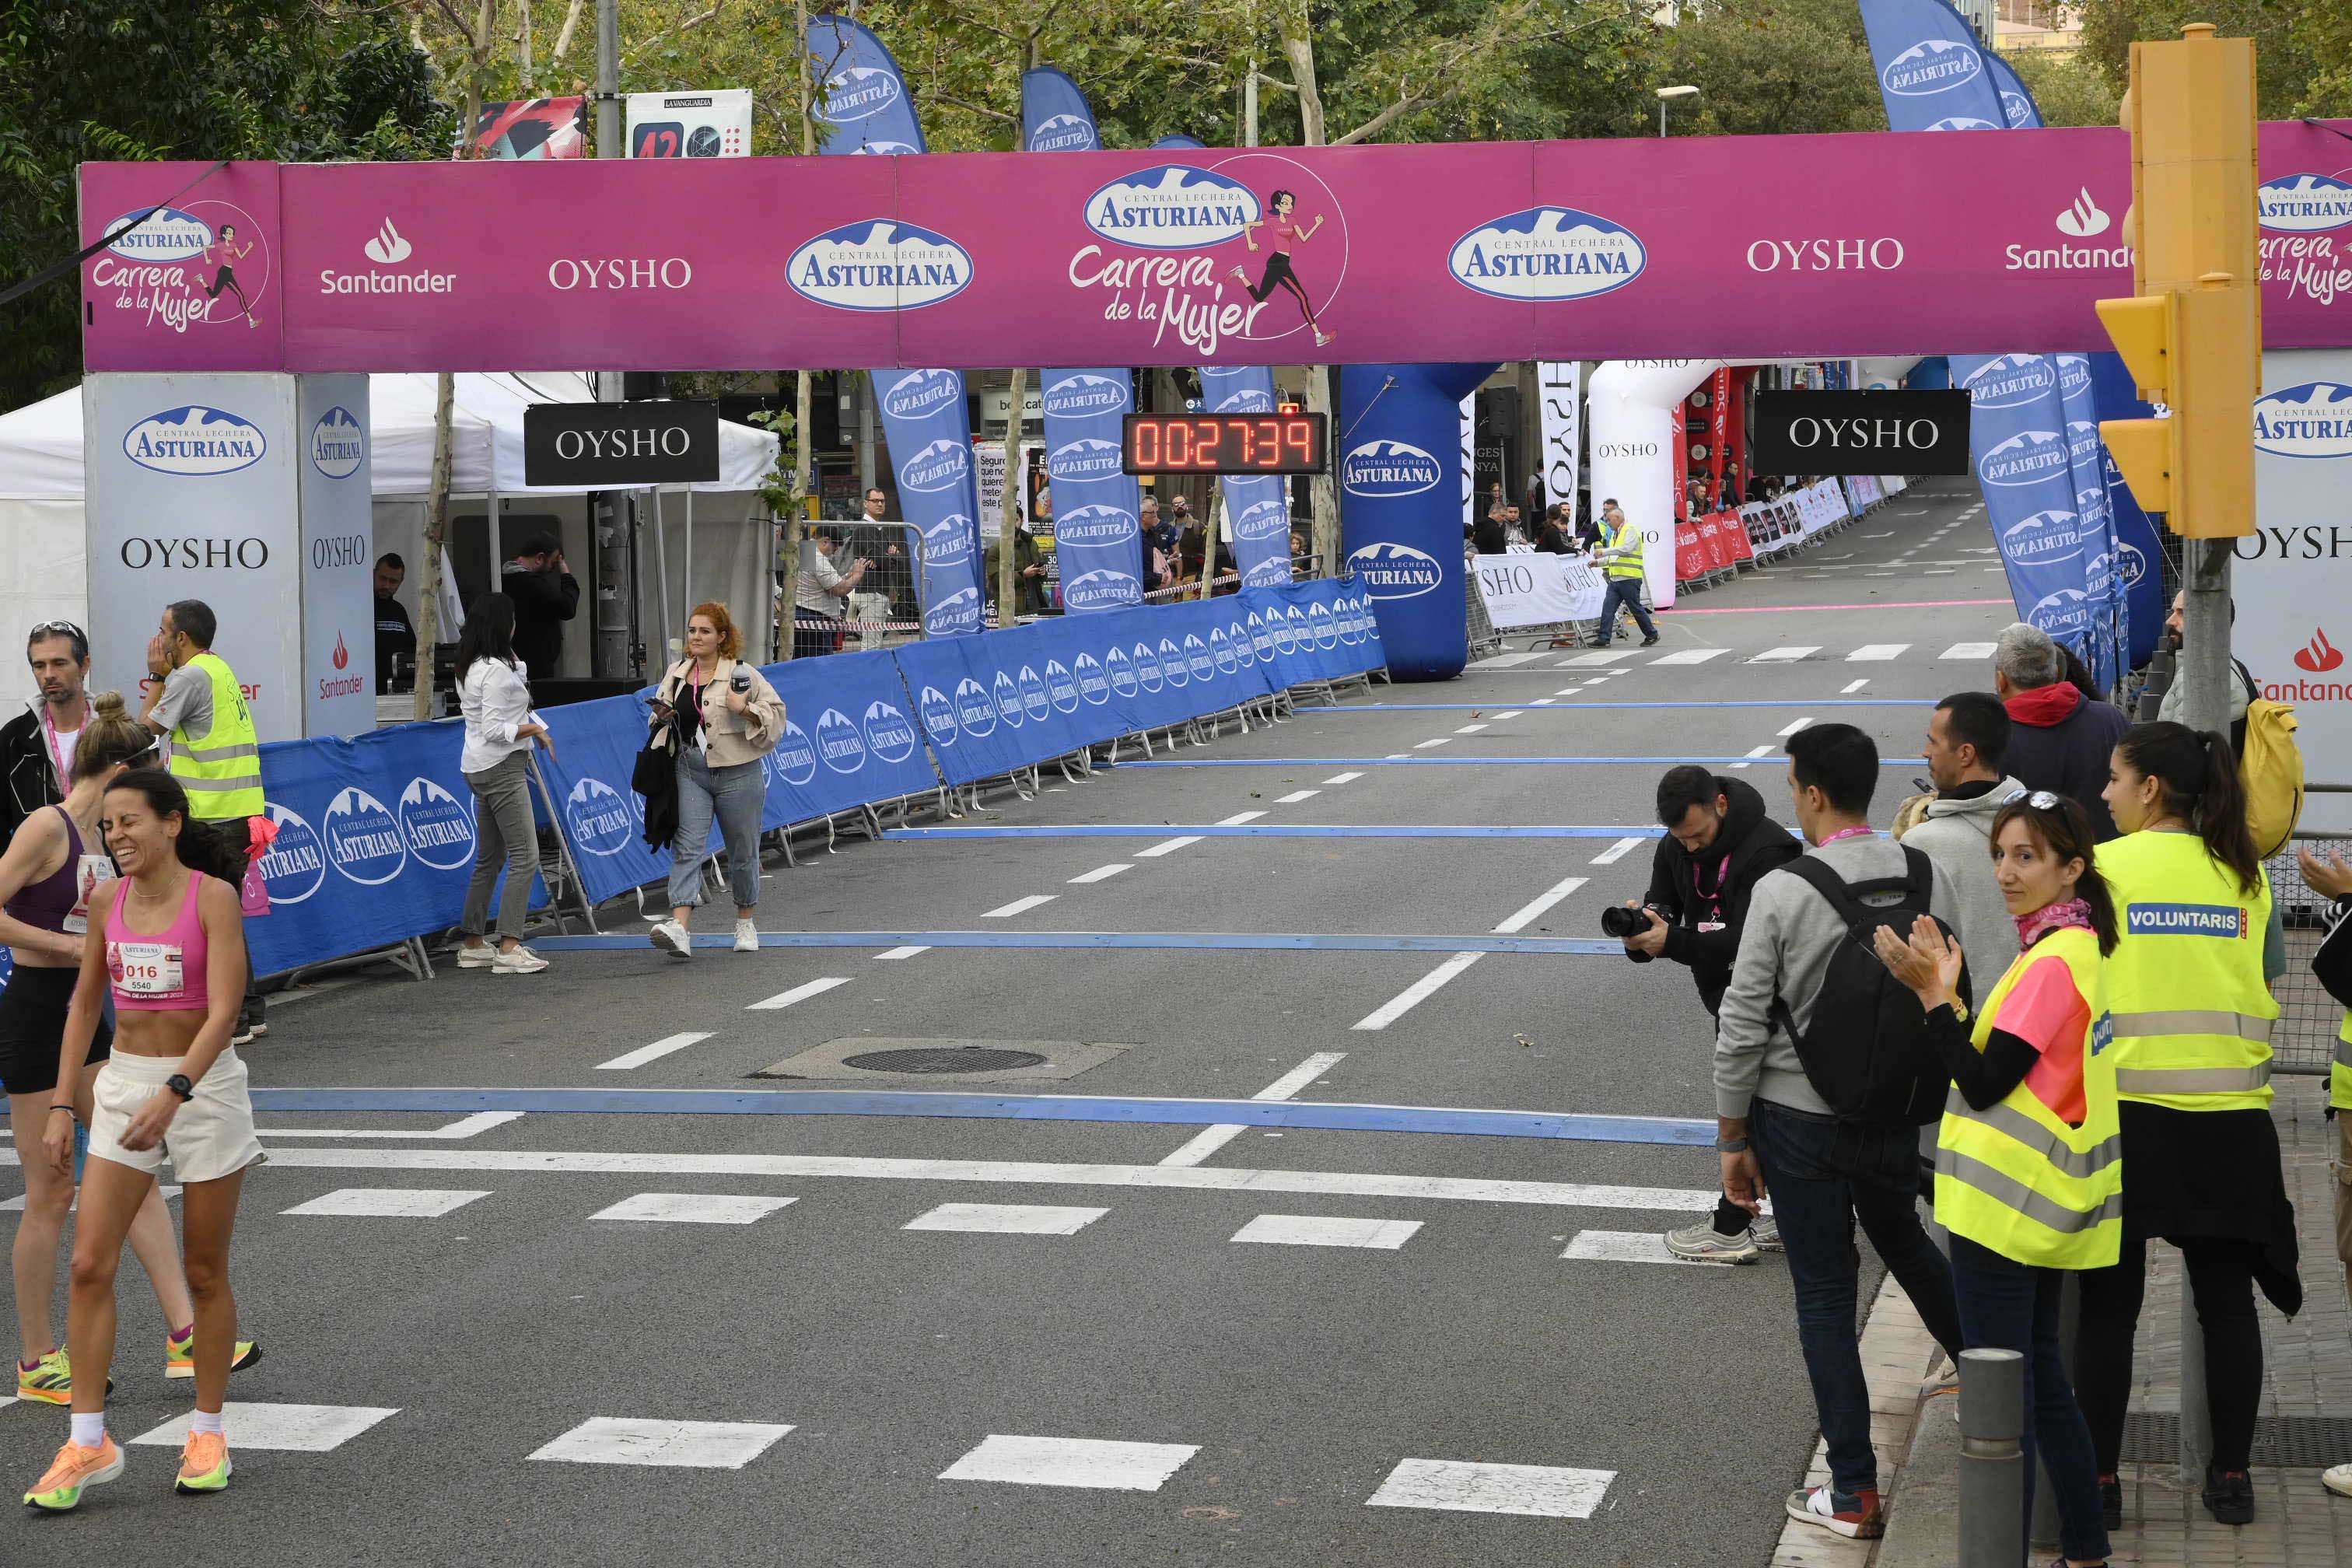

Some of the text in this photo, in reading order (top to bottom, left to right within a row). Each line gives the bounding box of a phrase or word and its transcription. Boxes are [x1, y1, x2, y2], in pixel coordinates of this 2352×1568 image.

[1097, 197, 1247, 228] ASTURIANA
[1124, 193, 1242, 203] CENTRAL LECHERA
[112, 226, 205, 247] ASTURIANA
[1494, 237, 1625, 250] CENTRAL LECHERA
[2259, 236, 2333, 258] arrera
[829, 250, 954, 260] CENTRAL LECHERA
[1069, 244, 1215, 289] Carrera
[1464, 243, 1632, 277] ASTURIANA
[1747, 237, 1905, 271] OYSHO
[93, 257, 184, 288] Carrera
[320, 269, 456, 294] Santander
[548, 258, 692, 290] OYSHO
[800, 254, 959, 287] ASTURIANA
[2277, 259, 2291, 281] la
[2287, 254, 2352, 305] Muje
[115, 285, 219, 333] de la Mujer
[1104, 282, 1269, 355] de la Mujer
[135, 431, 256, 458] ASTURIANA
[315, 434, 361, 462] ASTURIANA
[555, 426, 691, 460] OYSHO
[1136, 422, 1310, 465] 00:27:39
[1789, 417, 1939, 449] OYSHO
[1599, 443, 1657, 458] OYSHO
[1346, 463, 1434, 485] ASTURIANA
[121, 537, 268, 569] OYSHO
[313, 534, 366, 569] OYSHO
[1349, 565, 1435, 585] TURIANA
[320, 674, 363, 700] Santander
[821, 735, 863, 760] ASTURIANA
[339, 821, 366, 832] CENTRAL
[406, 814, 471, 850] ASTURIANA
[331, 827, 403, 864] ASTURIANA
[257, 845, 322, 881] STURIANA
[2130, 911, 2237, 929] VOLUNTARIS
[125, 945, 159, 954] ASTURIANA
[126, 965, 157, 978] 016
